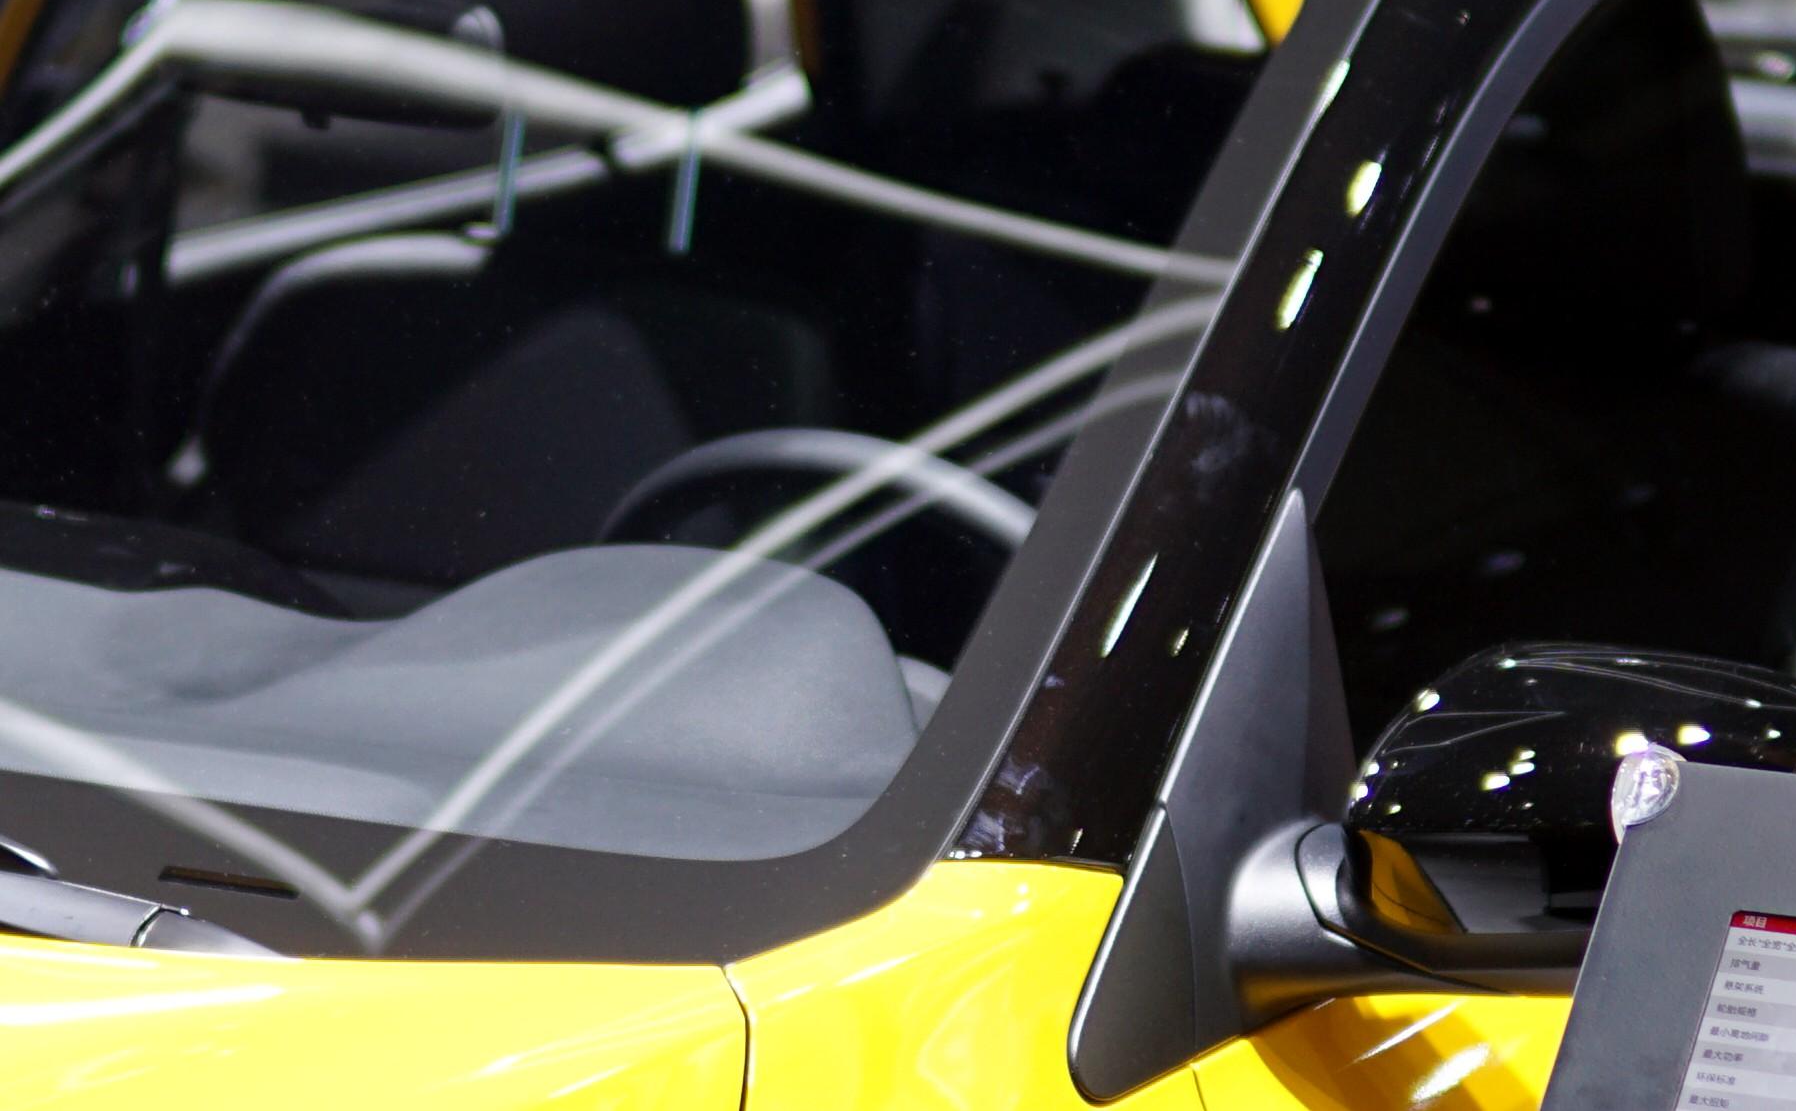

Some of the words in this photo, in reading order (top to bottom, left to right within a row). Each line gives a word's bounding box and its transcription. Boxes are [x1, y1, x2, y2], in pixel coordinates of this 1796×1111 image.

[1743, 915, 1768, 929] 项目
[1730, 958, 1761, 971] 排气量
[1703, 1049, 1744, 1062] 最大功率
